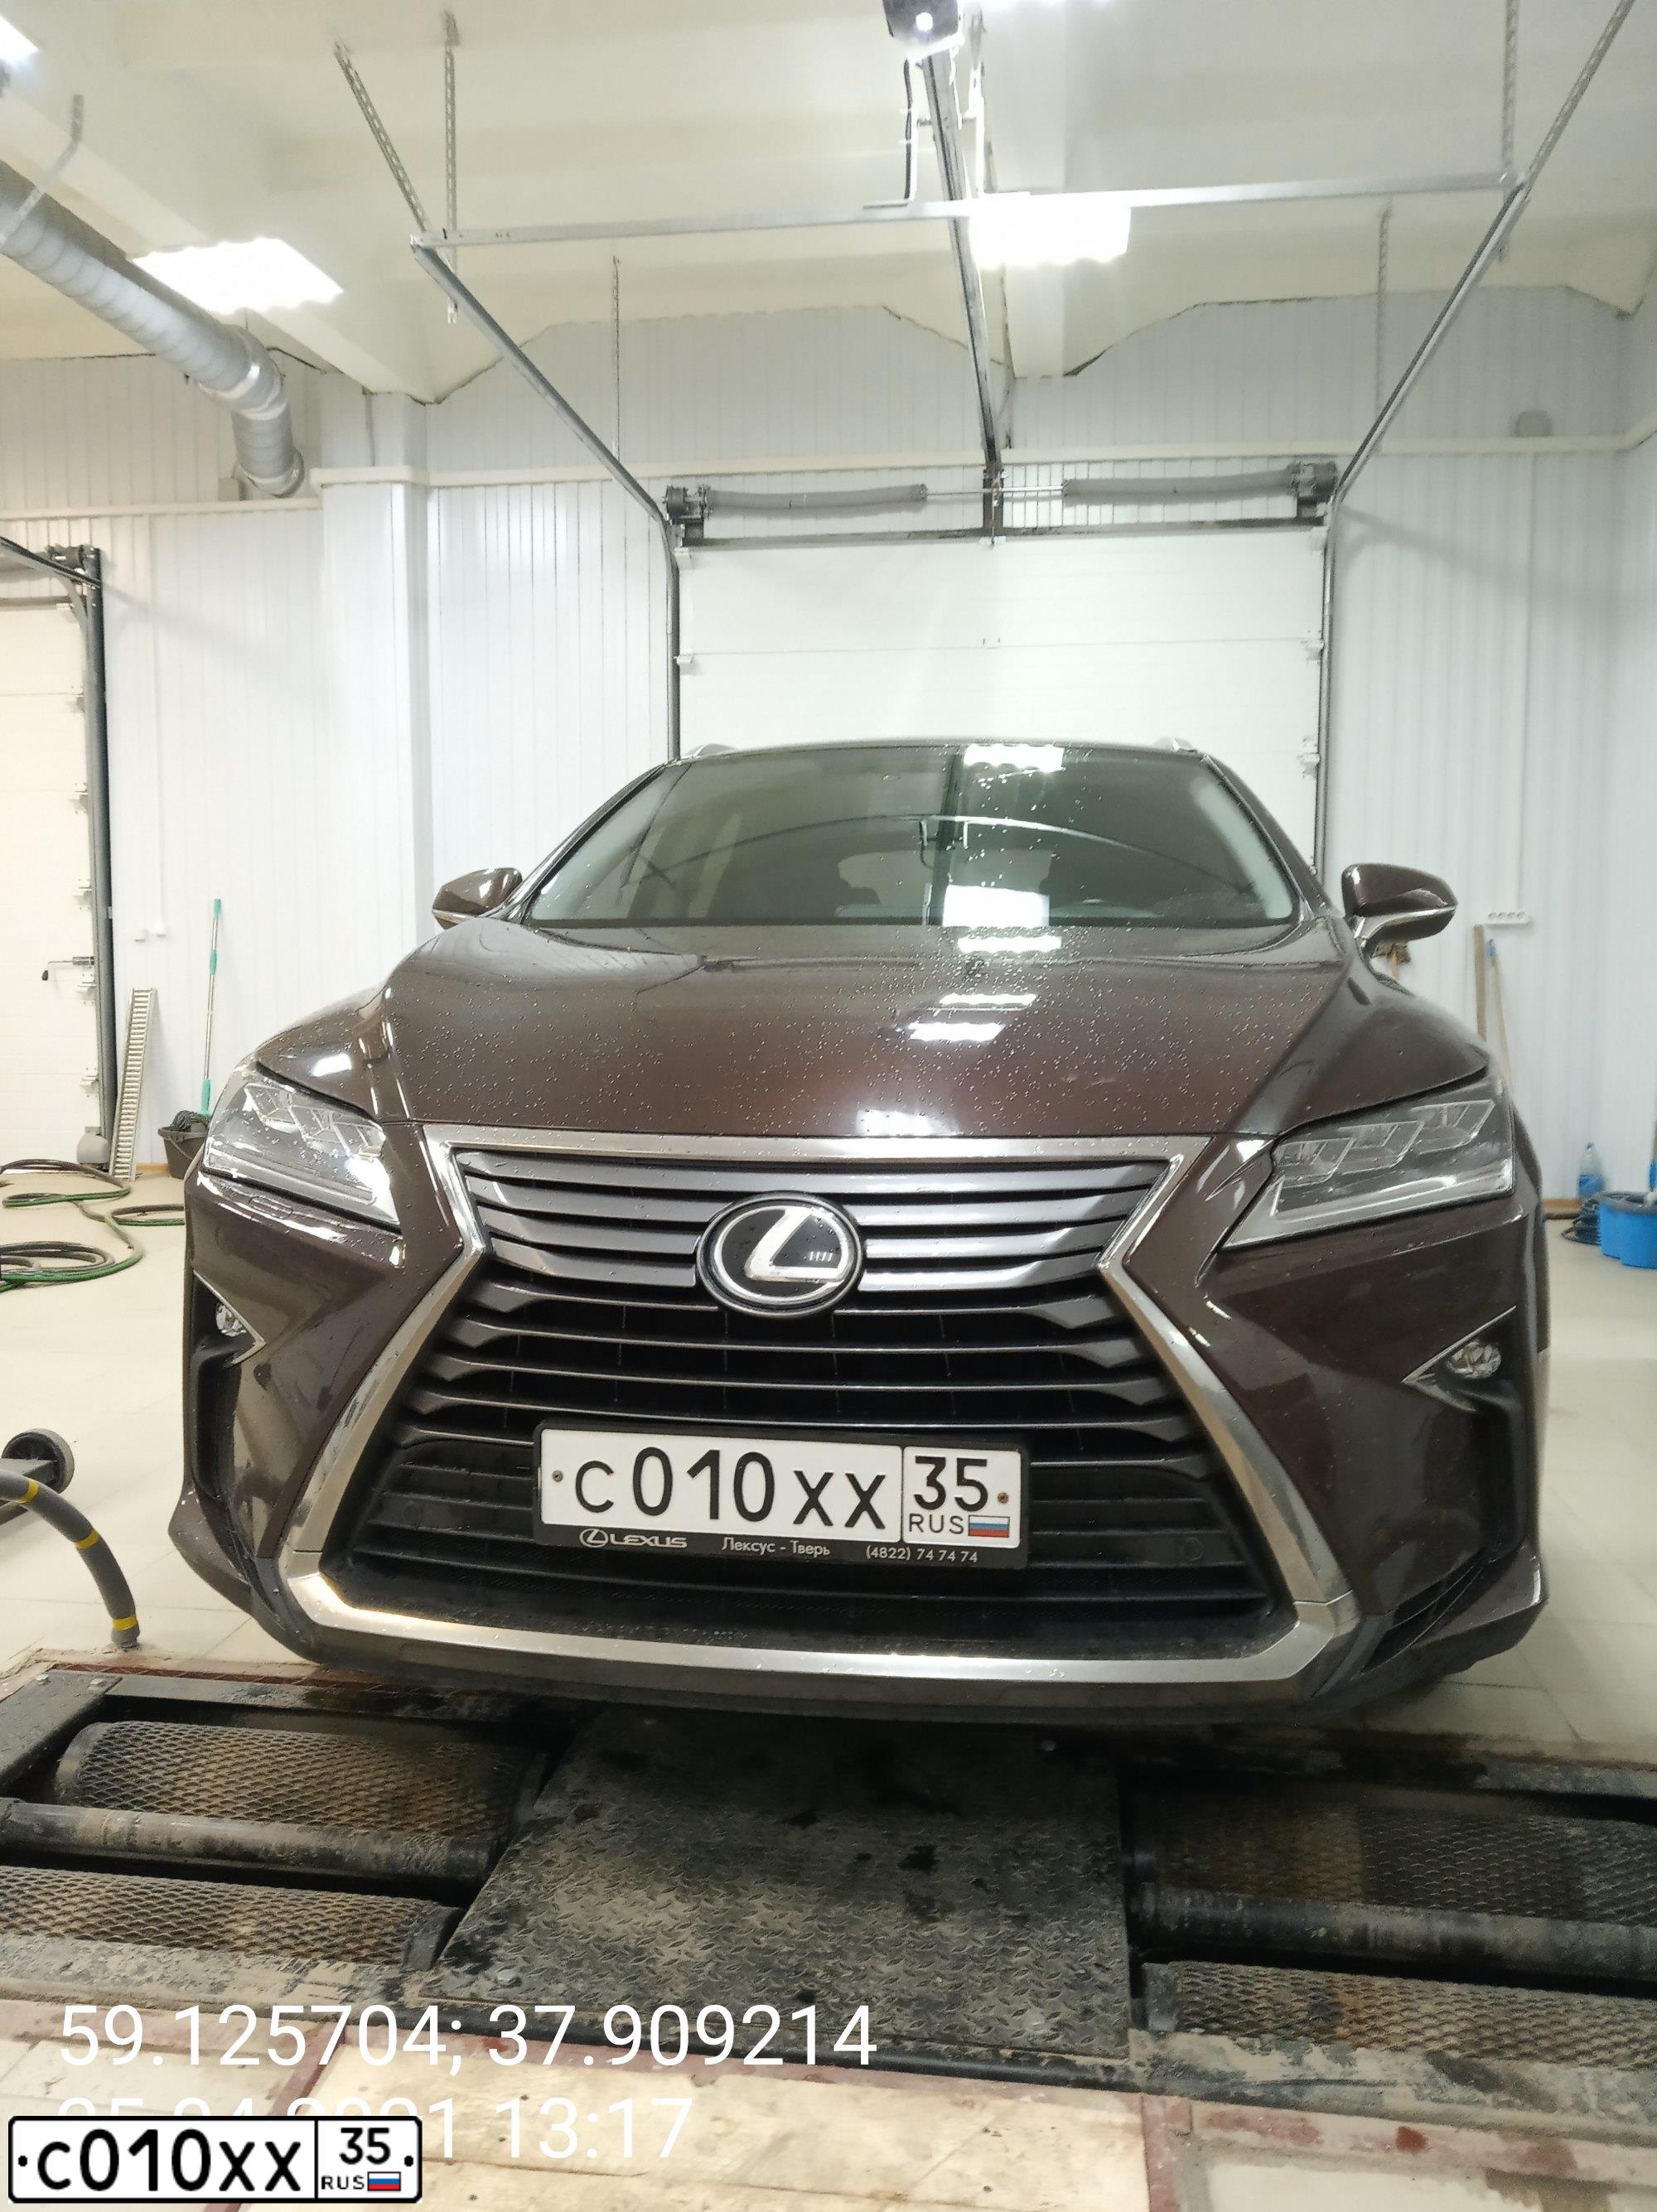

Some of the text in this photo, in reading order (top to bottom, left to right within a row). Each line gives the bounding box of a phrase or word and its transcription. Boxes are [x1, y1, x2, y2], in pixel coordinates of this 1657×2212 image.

[913, 1456, 988, 1512] 35
[909, 1513, 964, 1534] RUS
[609, 1533, 688, 1548] LEXUS
[721, 1536, 776, 1556] Лексус
[789, 1539, 831, 1558] Тверь
[865, 1546, 978, 1563] (4822) 74 74 74
